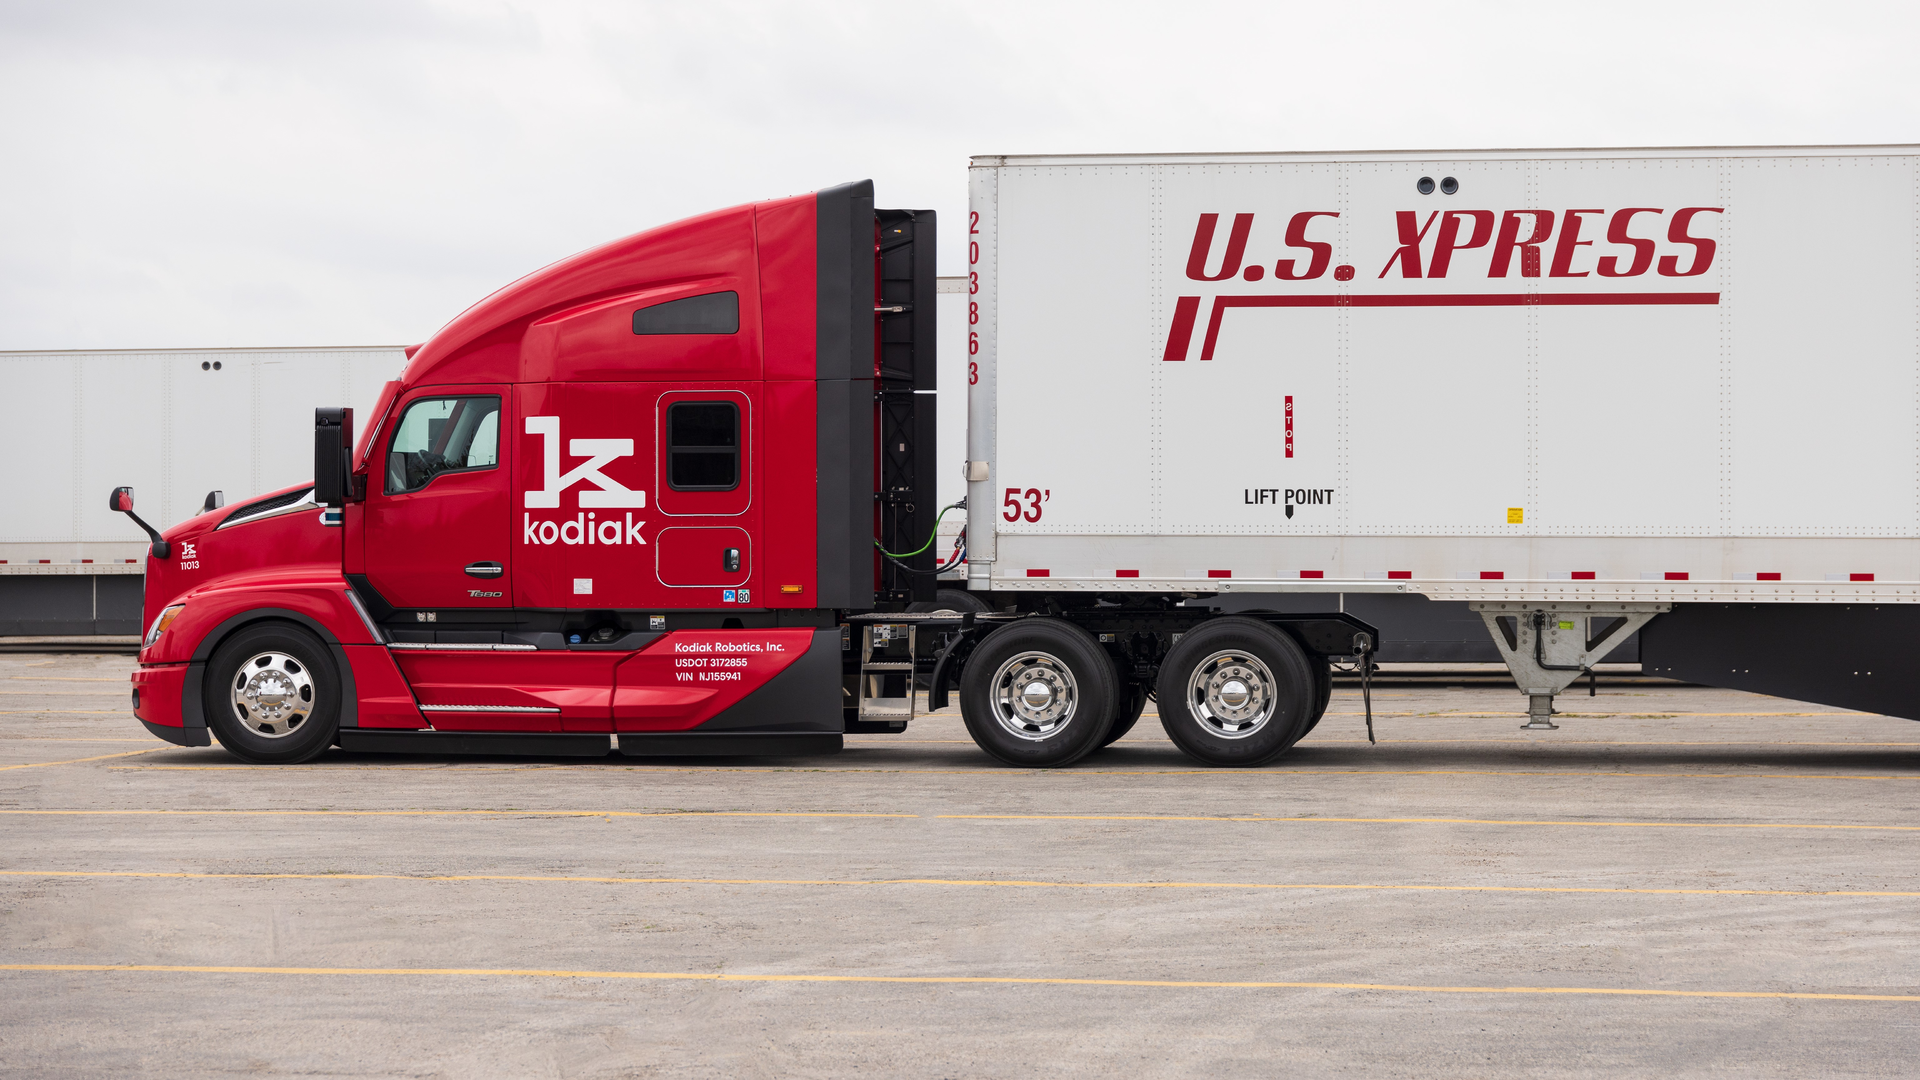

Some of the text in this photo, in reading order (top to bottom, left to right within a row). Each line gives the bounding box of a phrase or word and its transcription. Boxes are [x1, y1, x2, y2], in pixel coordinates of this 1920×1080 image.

[1185, 207, 1725, 282] U.S. XPRESS
[969, 211, 979, 386] 203863
[1244, 488, 1334, 505] LIFT POINT
[523, 512, 647, 545] kodiak
[180, 561, 200, 570] 11013
[467, 589, 503, 598] T680
[674, 641, 785, 653] Kodiak Robotics, Inc.
[675, 657, 748, 668] USDOT 3172855
[675, 672, 741, 682] VIN NJ155941
